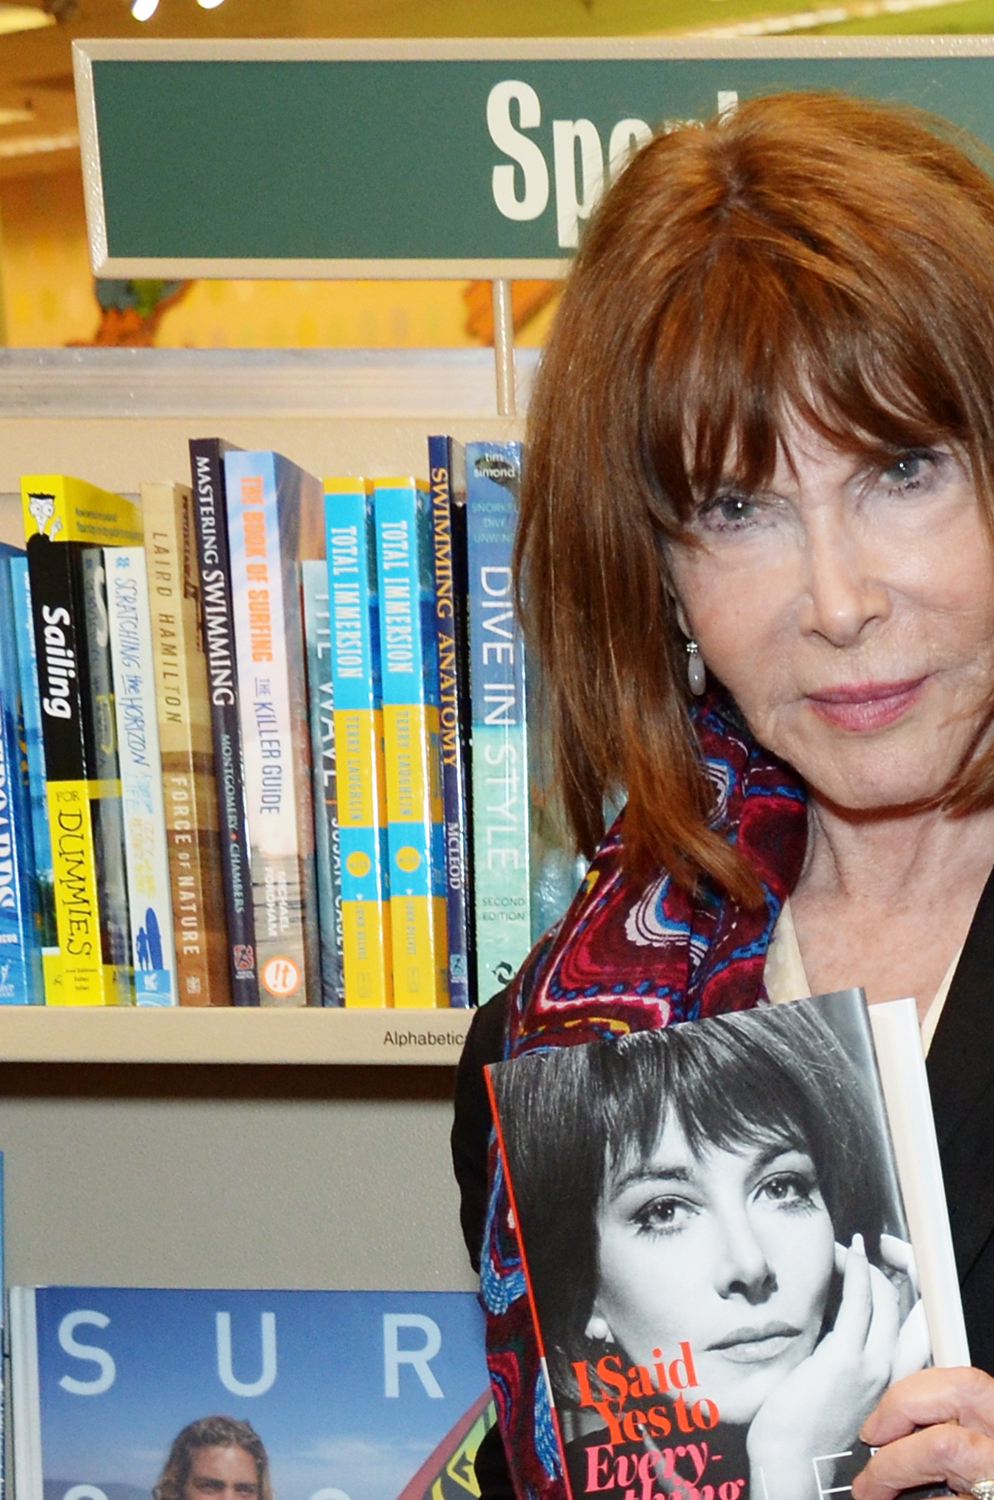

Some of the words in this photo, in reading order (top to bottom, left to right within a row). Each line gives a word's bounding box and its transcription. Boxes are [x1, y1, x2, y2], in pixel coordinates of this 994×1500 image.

[483, 80, 738, 248] Spo
[196, 456, 220, 565] MASTERING
[240, 475, 264, 505] THE
[151, 532, 172, 598] LAIRD
[242, 511, 267, 558] BOOK
[331, 525, 359, 575] TOTAL
[431, 467, 454, 619] SWIMMING
[245, 562, 269, 582] OF
[115, 577, 142, 670] SCRATCHING
[202, 569, 236, 707] SWIMMING
[247, 587, 274, 663] SURFING
[333, 582, 363, 679] IMMERSION
[480, 566, 515, 665] DIVE
[42, 604, 75, 719] Sailing
[157, 613, 183, 725] HAMILTON
[256, 676, 271, 695] THE
[118, 691, 150, 768] HORIZON
[437, 632, 457, 768] ANATOMY
[484, 682, 517, 726] IN
[56, 790, 81, 802] FOR
[170, 776, 192, 844] FORCE
[220, 733, 240, 831] MONTGOMERY
[484, 746, 521, 871] STYLE
[57, 808, 92, 959] DUMMIES
[177, 852, 191, 869] OF
[229, 843, 245, 914] CHAMBERS
[446, 822, 462, 891] MCLEOD
[177, 875, 200, 955] NATURE
[483, 897, 526, 908] SECOND
[483, 911, 526, 922] EDITION
[571, 1361, 597, 1408] I
[596, 1340, 700, 1404] Said
[591, 1400, 673, 1446] Yes
[673, 1391, 721, 1434] to
[584, 1441, 723, 1494] Every-
